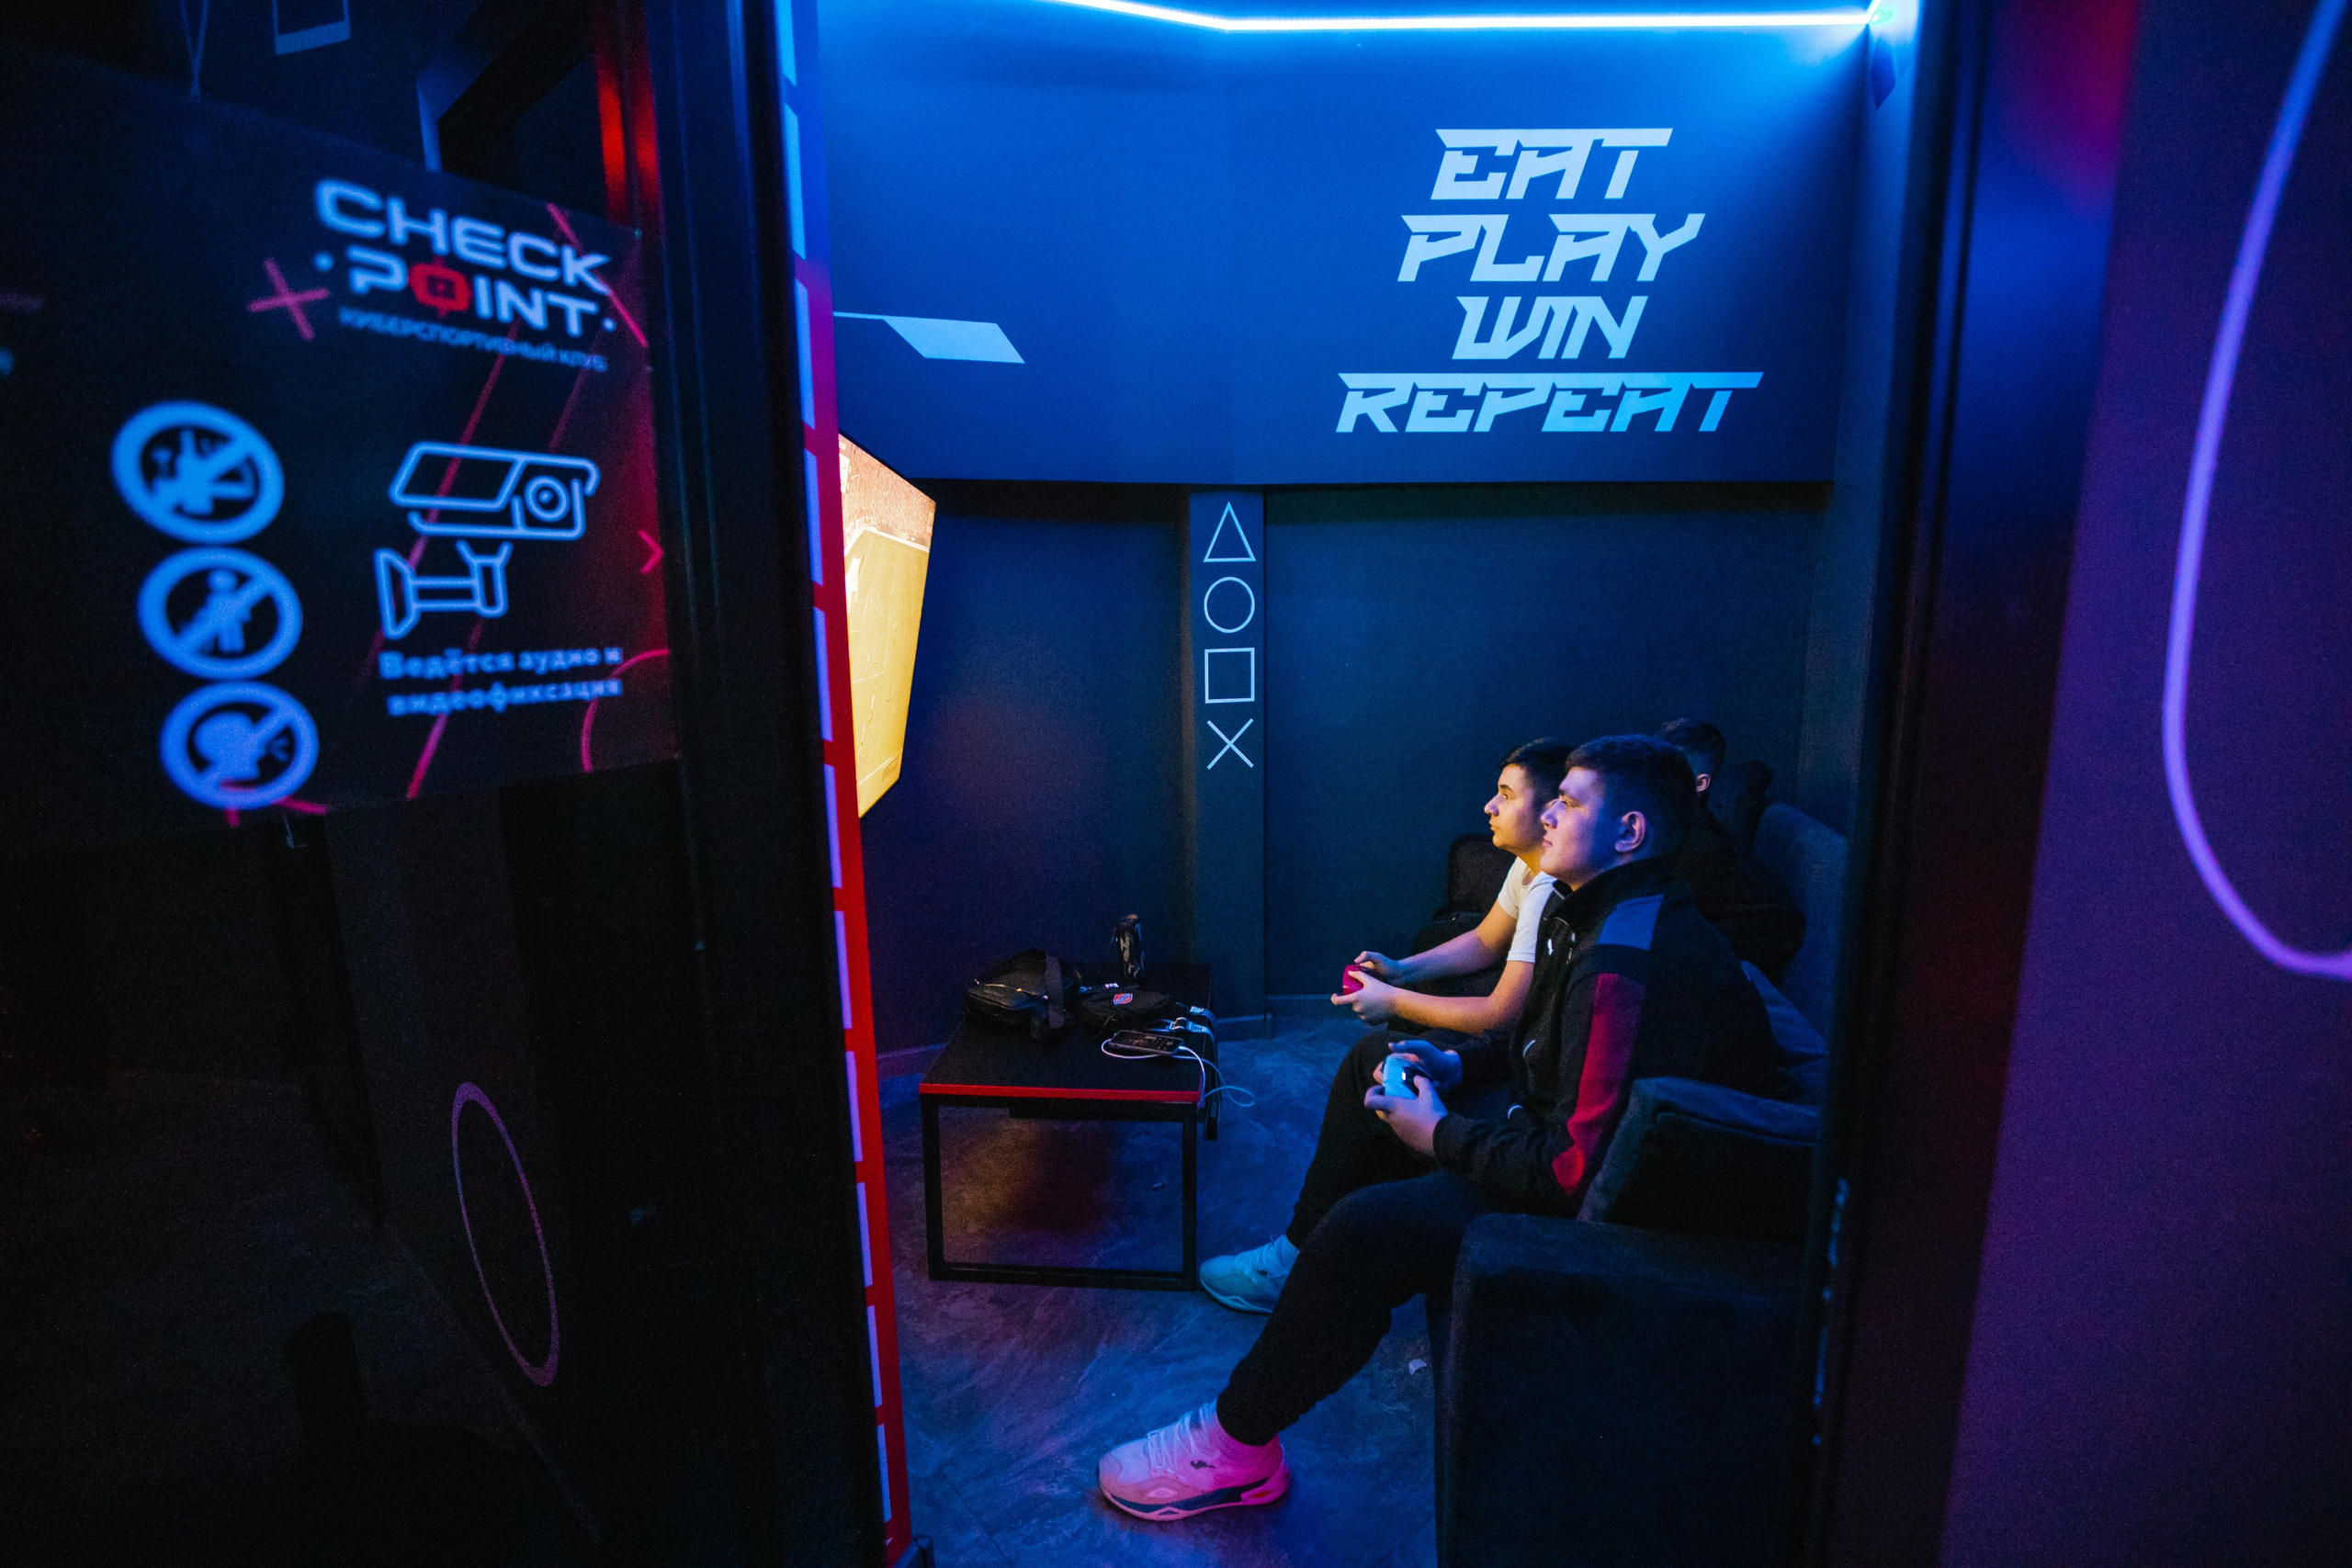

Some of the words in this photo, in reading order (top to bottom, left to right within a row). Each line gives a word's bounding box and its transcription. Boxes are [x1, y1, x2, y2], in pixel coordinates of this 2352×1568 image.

[1430, 128, 1673, 200] EAT
[313, 178, 611, 296] CHECK
[1397, 213, 1706, 282] PLAY
[345, 245, 599, 337] POINT
[1452, 296, 1649, 359] WIN
[1335, 372, 1764, 432] REPEAT
